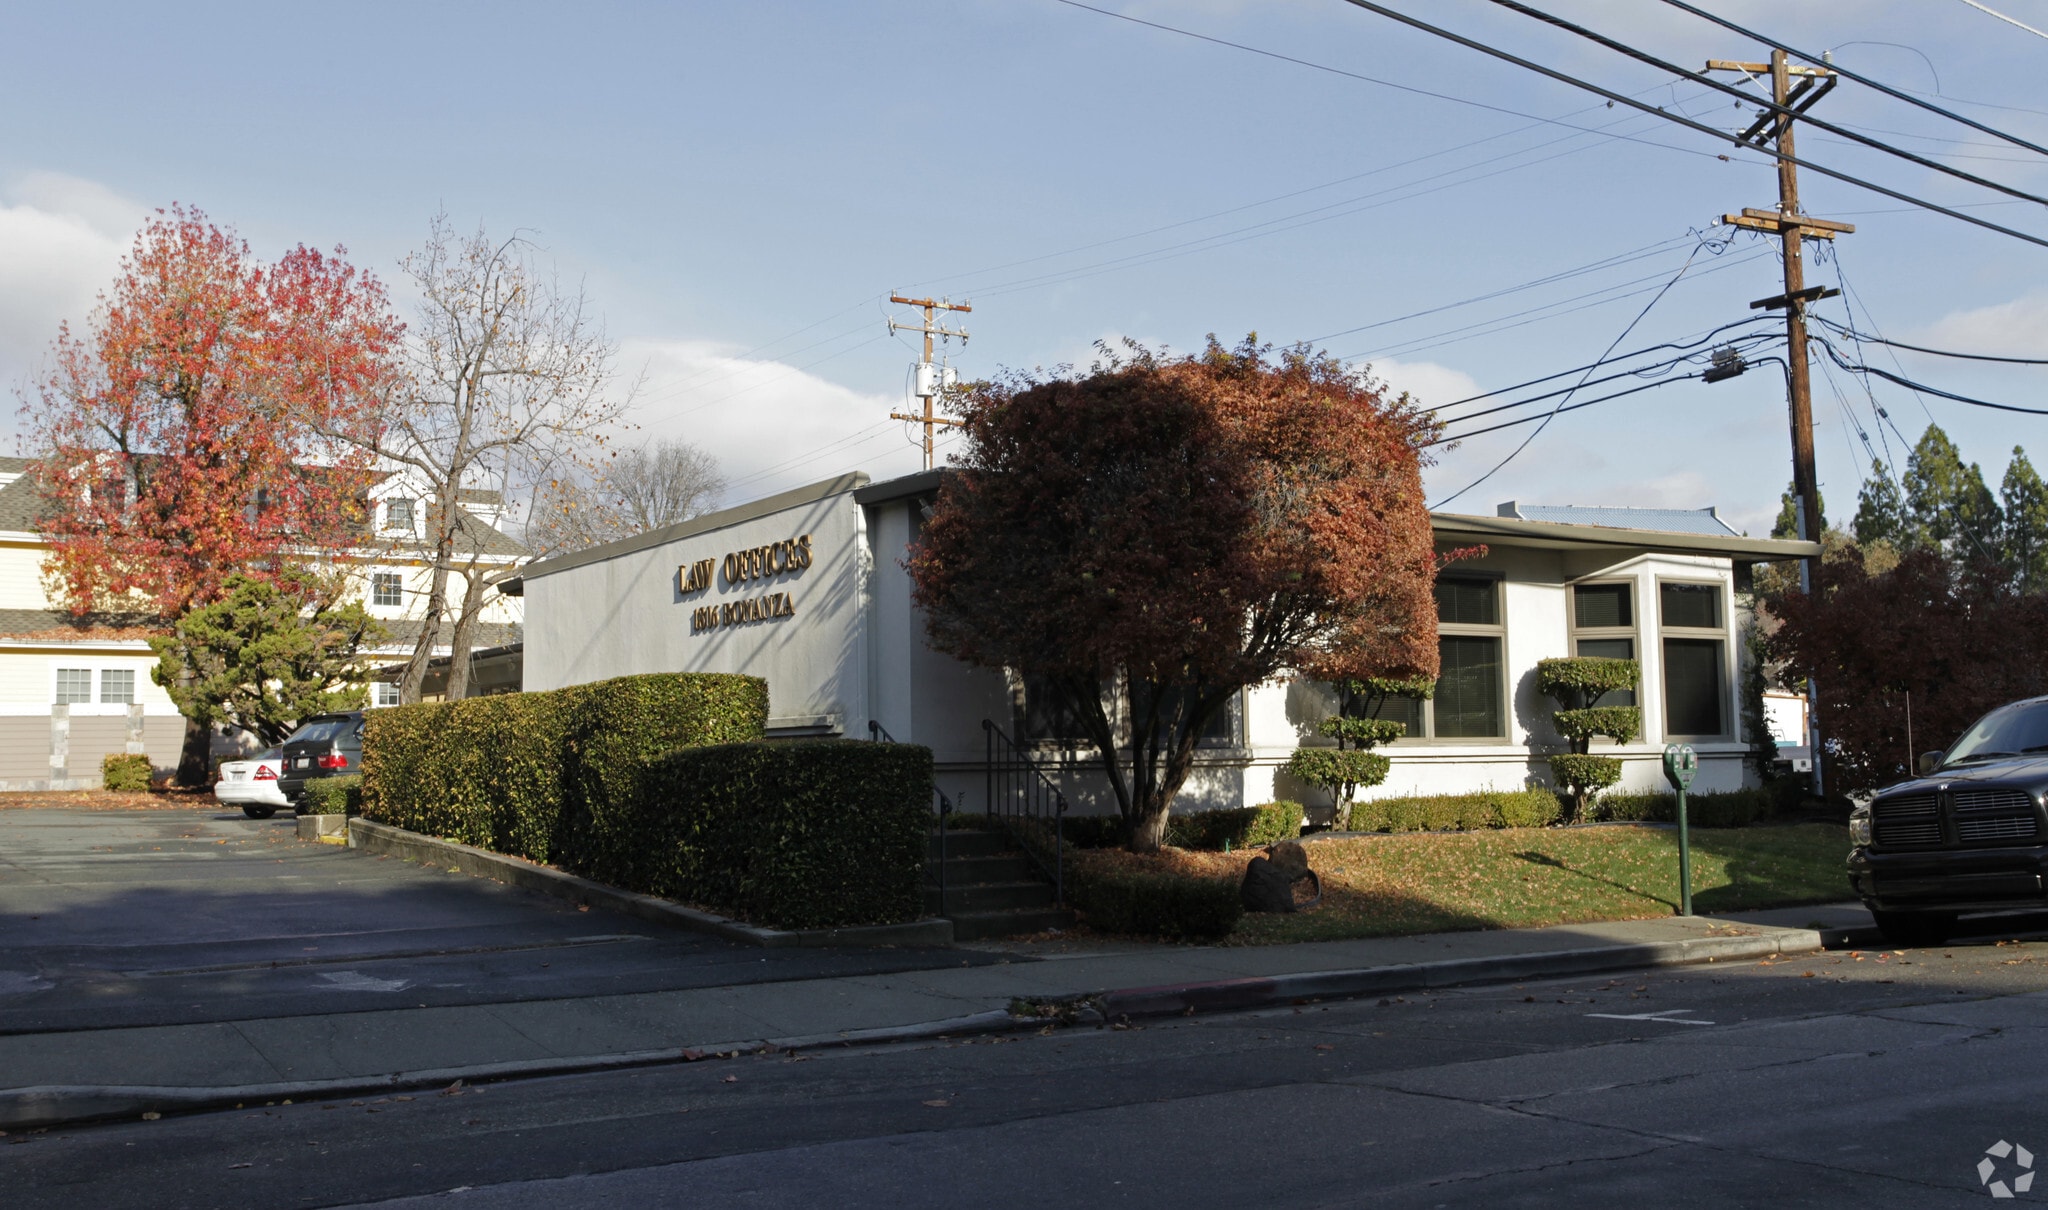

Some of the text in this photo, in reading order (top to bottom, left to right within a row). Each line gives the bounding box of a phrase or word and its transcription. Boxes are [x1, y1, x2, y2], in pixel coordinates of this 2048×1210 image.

[679, 534, 813, 594] LAW OFFICES
[722, 591, 796, 627] BONANZA
